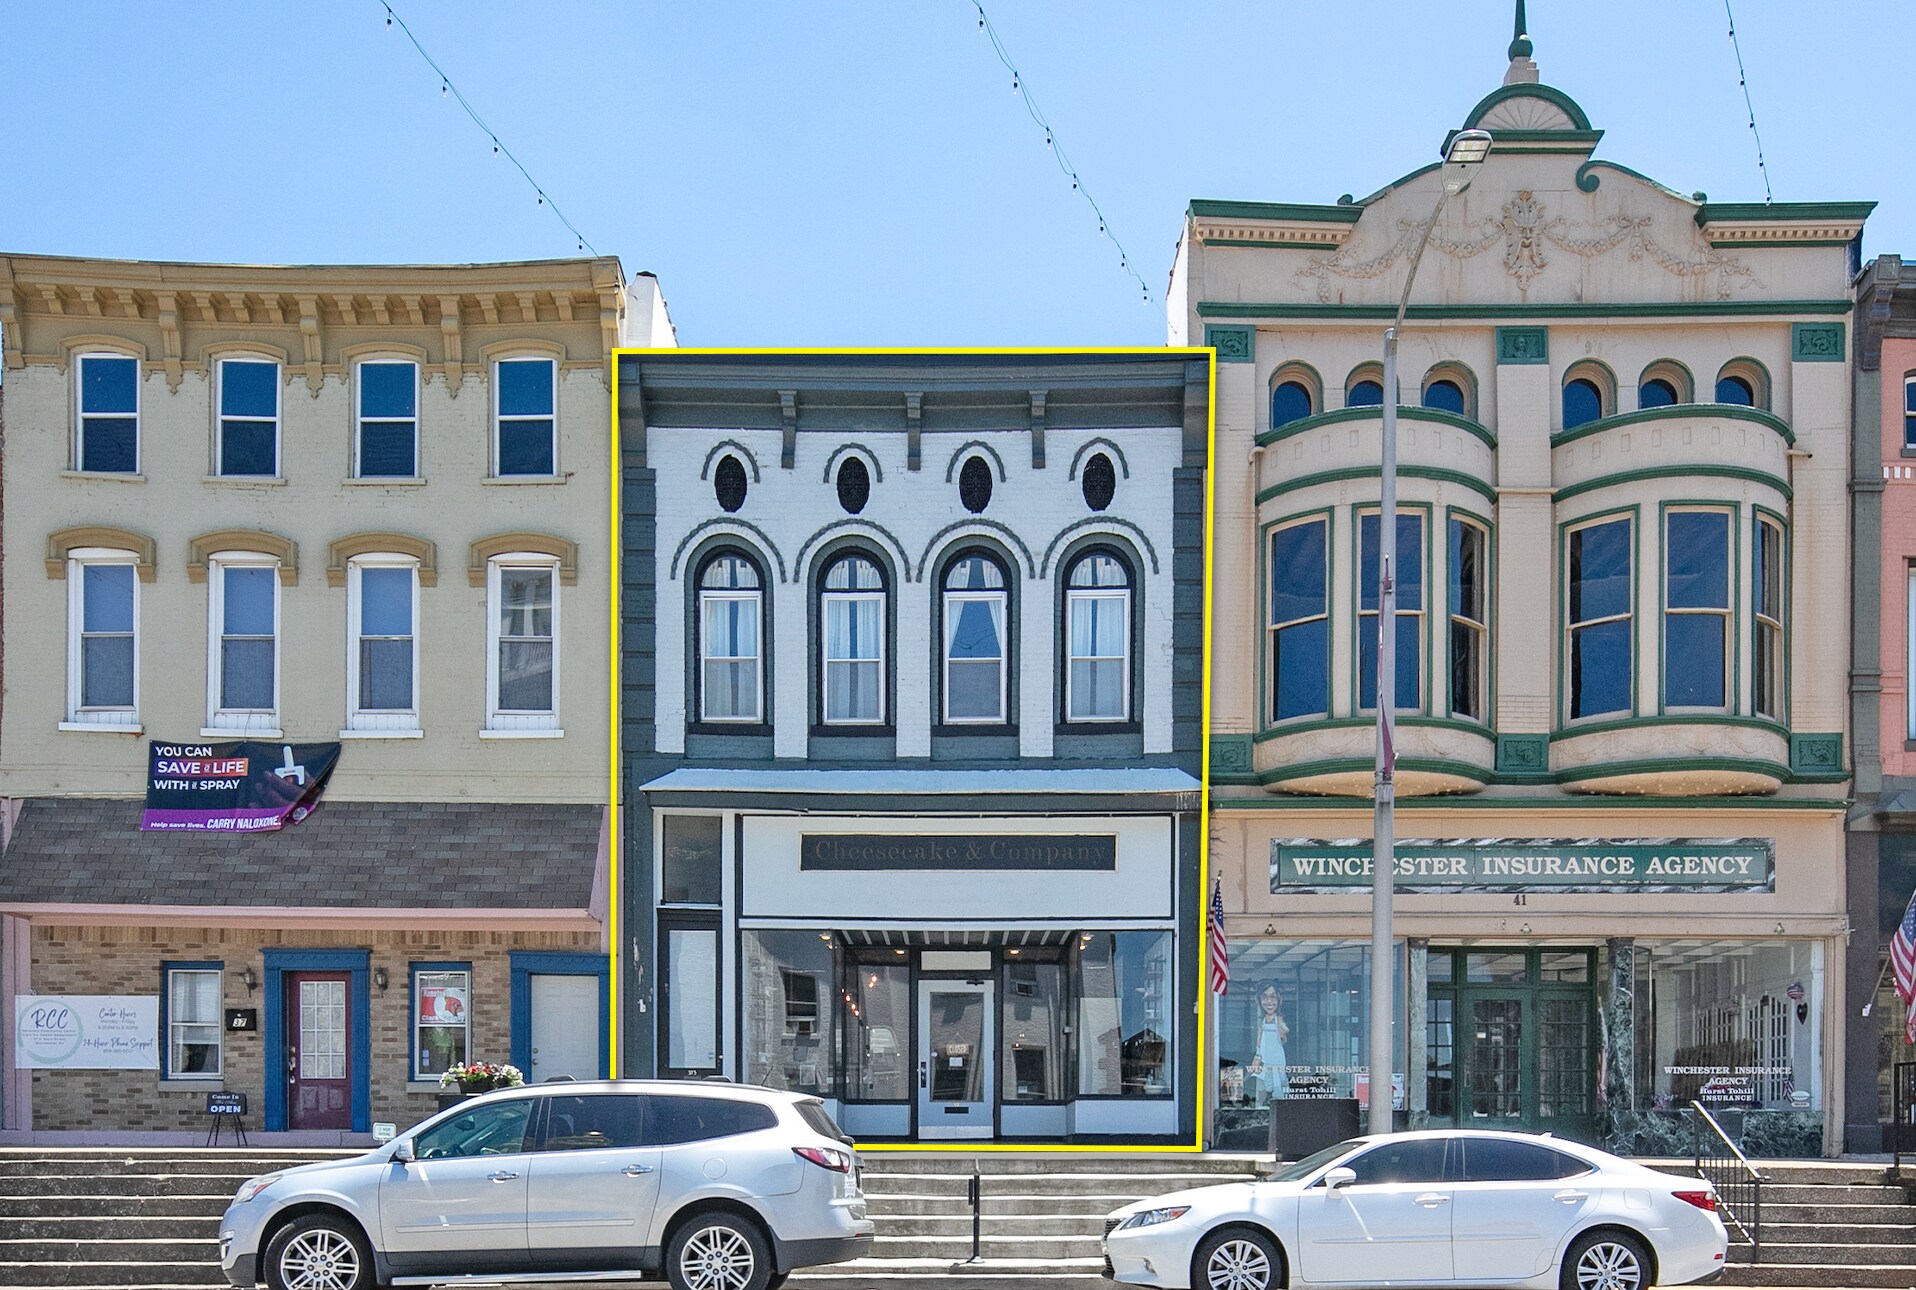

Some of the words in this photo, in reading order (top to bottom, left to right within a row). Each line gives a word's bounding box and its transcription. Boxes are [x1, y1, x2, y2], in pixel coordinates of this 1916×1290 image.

[155, 747, 182, 757] YOU
[184, 747, 213, 757] CAN
[157, 761, 201, 774] SAVE
[203, 764, 211, 772] a
[212, 761, 245, 773] LIFE
[154, 780, 189, 790] WITH
[199, 779, 240, 790] SPRAY
[150, 821, 168, 830] Help
[207, 818, 236, 830] CARRY
[237, 815, 282, 829] NALOXONE.
[815, 840, 958, 861] Cheesecake
[965, 841, 982, 861] &
[990, 840, 1106, 865] Company
[1482, 856, 1635, 876] INSURANCE
[1645, 856, 1753, 875] AGENCY
[1513, 895, 1527, 906] 41
[30, 1008, 68, 1029] RCC
[119, 1007, 137, 1020] Hours
[233, 1018, 247, 1027] 37
[110, 1037, 129, 1048] Phone
[129, 1037, 153, 1051] Support
[948, 1045, 967, 1053] CLOSED
[1664, 1066, 1730, 1075] WINCHESTER
[1734, 1066, 1792, 1075] INSURANCE
[1289, 1076, 1329, 1084] AGENCY
[1708, 1077, 1749, 1085] AGENCY
[210, 1105, 241, 1113] OPEN
